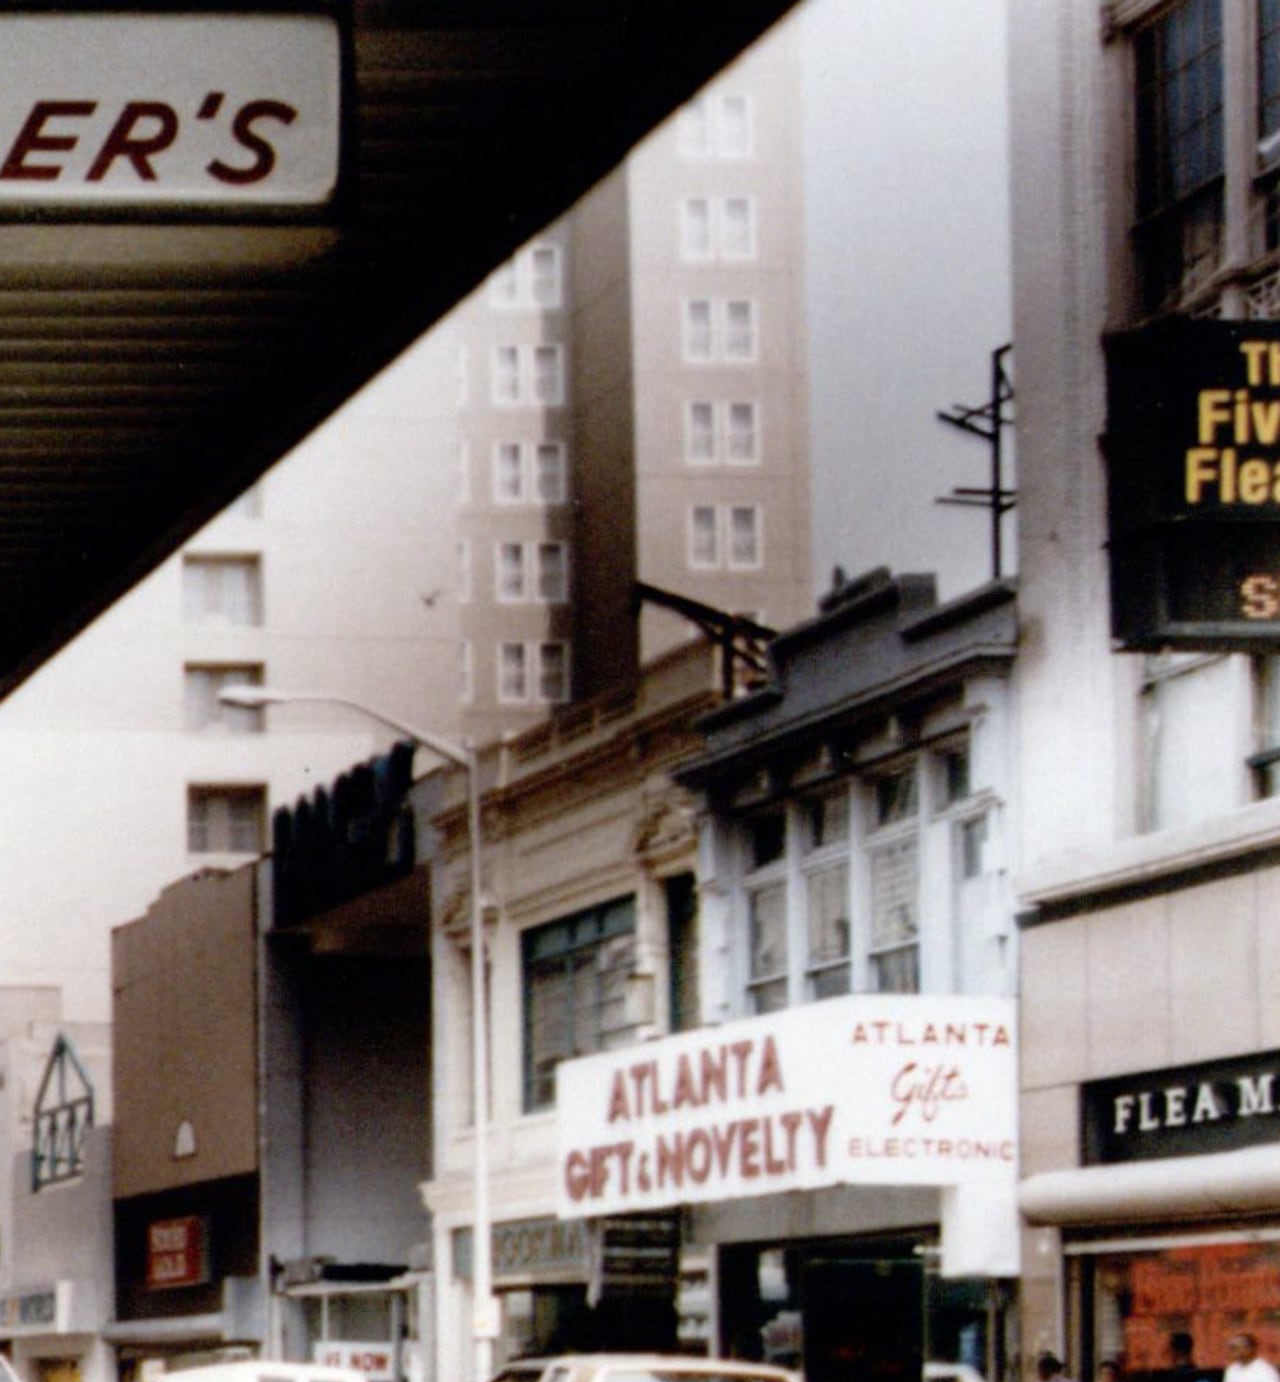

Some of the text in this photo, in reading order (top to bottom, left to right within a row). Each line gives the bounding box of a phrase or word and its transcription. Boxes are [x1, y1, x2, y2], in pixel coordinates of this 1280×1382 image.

[1185, 447, 1280, 505] Fle
[851, 1021, 1011, 1047] ATLANTA
[608, 1035, 785, 1124] ATLANTA
[1113, 1073, 1280, 1134] FLEA M
[656, 1105, 835, 1189] NOVELTY
[847, 1136, 1015, 1163] ELECTRONIC
